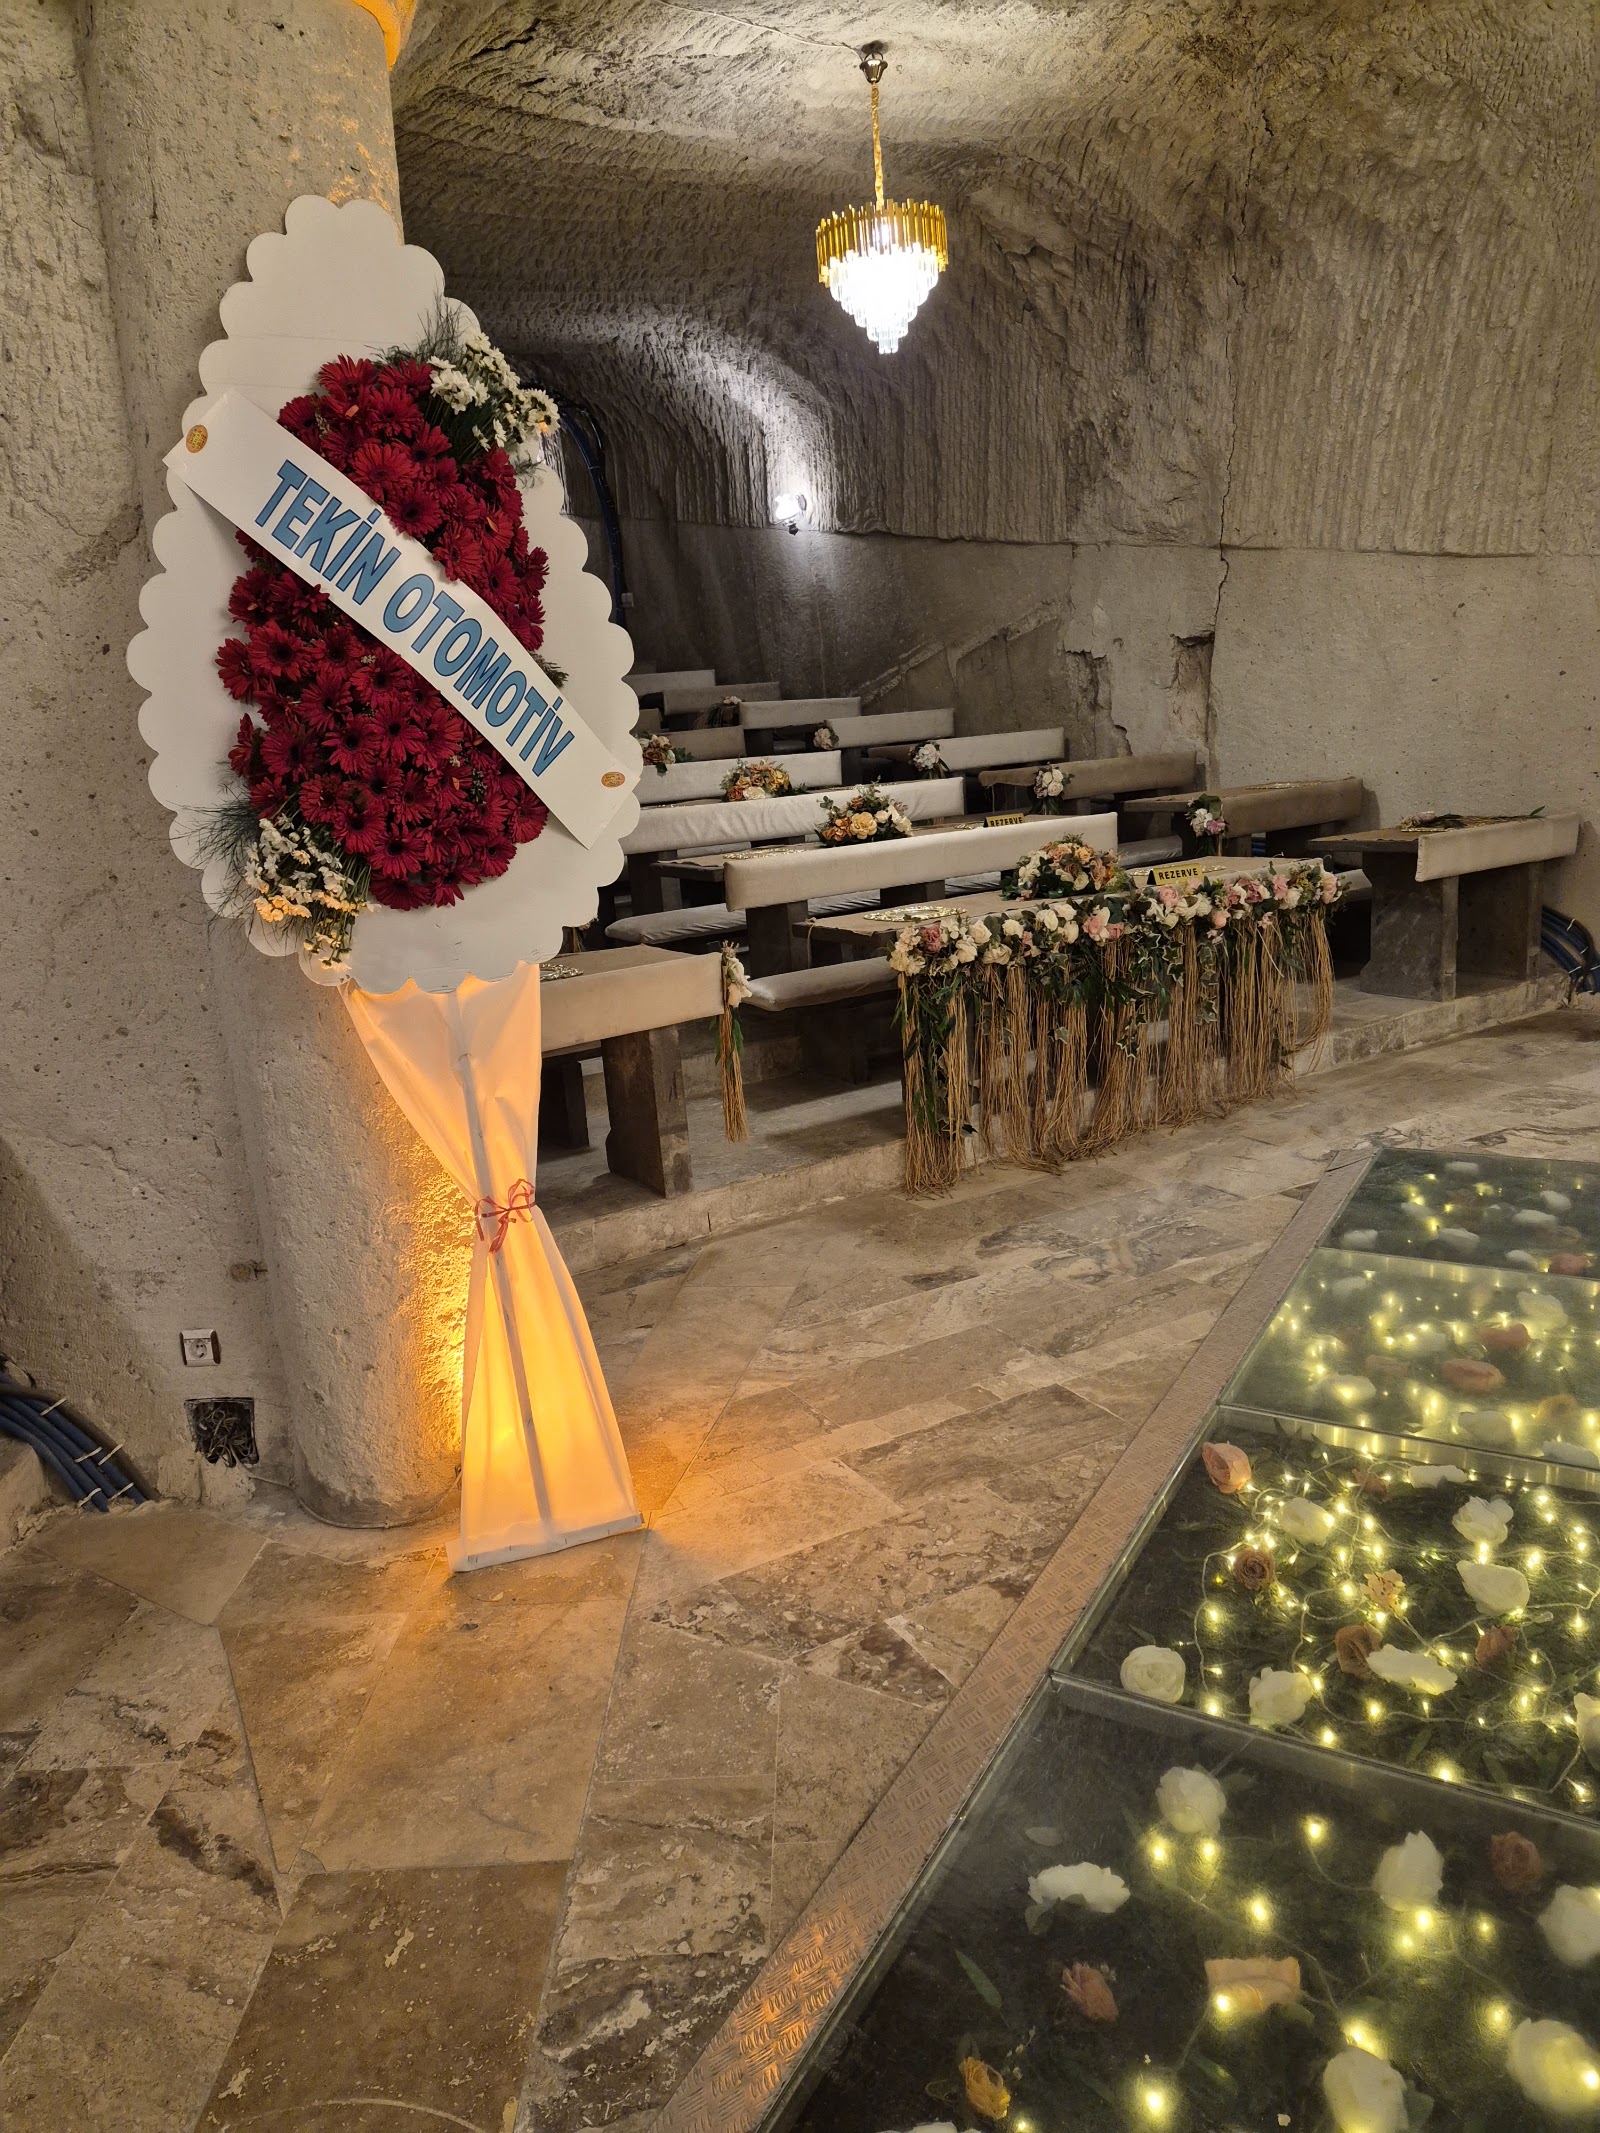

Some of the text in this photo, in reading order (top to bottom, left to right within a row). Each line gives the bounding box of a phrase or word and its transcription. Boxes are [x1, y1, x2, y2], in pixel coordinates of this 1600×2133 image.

[254, 459, 575, 777] TEKİN OTOMOTİV
[1158, 868, 1199, 880] REZERVE
